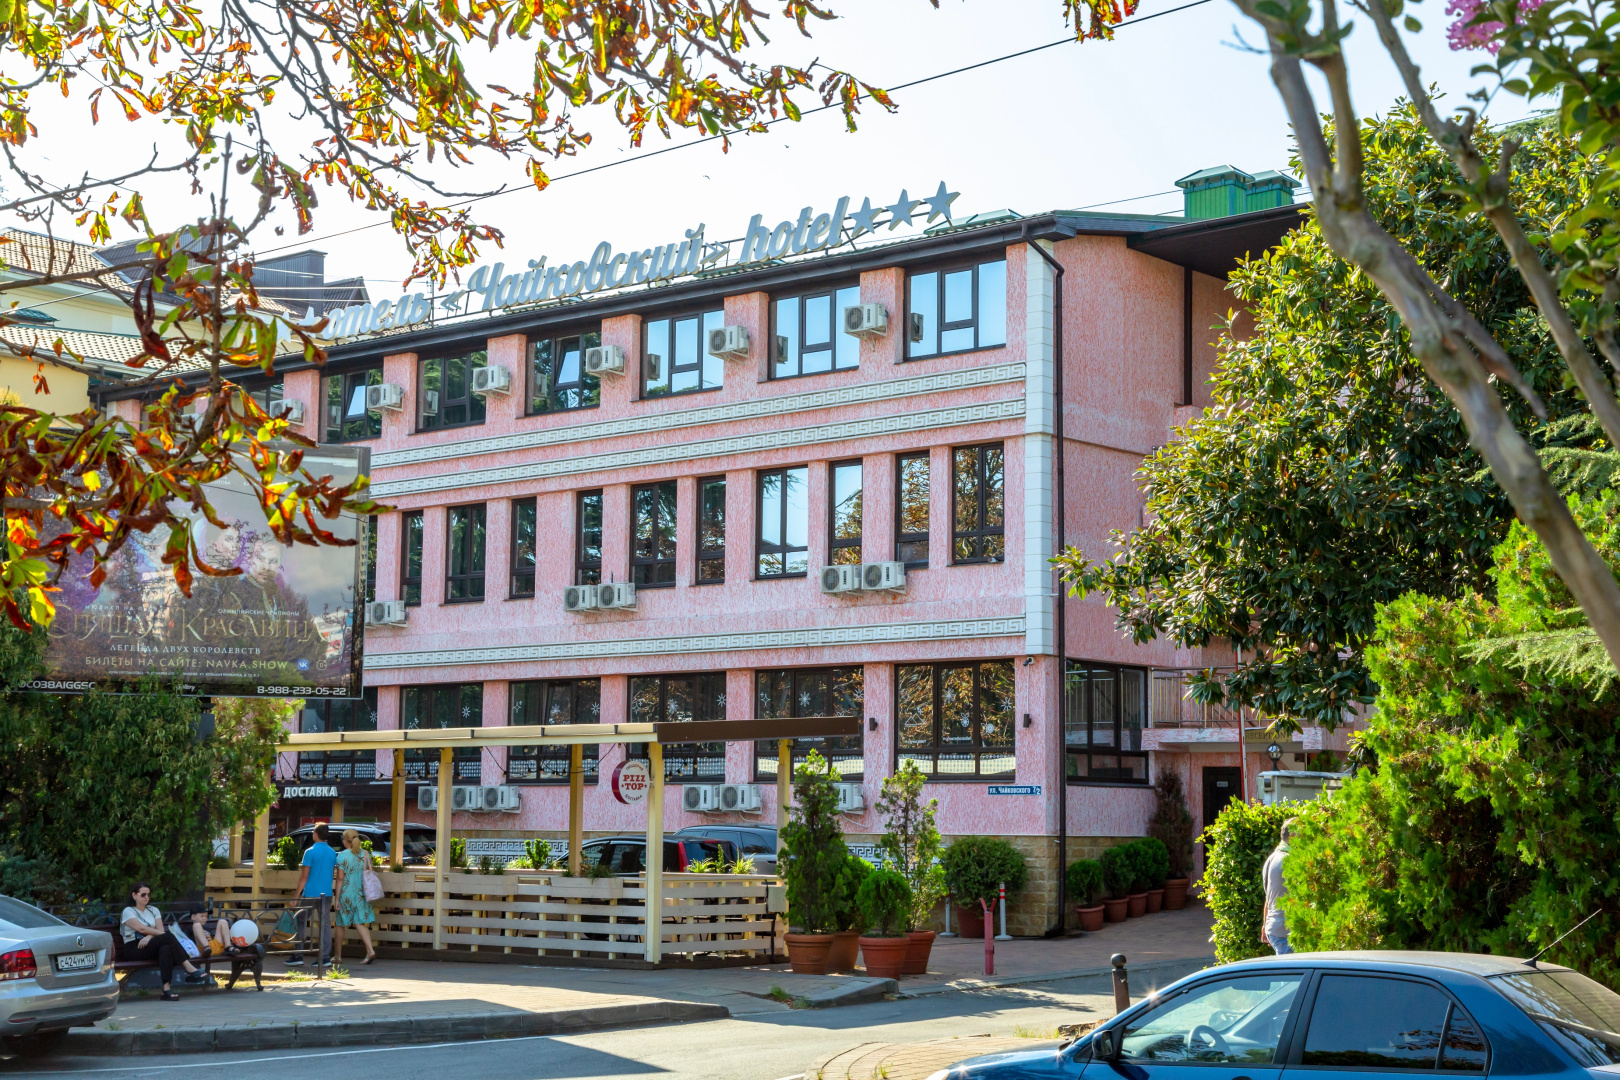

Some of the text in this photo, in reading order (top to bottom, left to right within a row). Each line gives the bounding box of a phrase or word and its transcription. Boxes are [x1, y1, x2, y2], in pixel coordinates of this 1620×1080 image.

[739, 195, 850, 266] hotel
[162, 645, 189, 653] ДВУХ
[193, 646, 261, 655] КОРОЛЕВСТВ
[85, 656, 201, 668] БИЛЕТЫ НА САЙТЕ:
[206, 659, 288, 669] NAVKA.SHOW
[257, 686, 347, 696] 8-988-233-05-22
[1245, 732, 1286, 740] RECEPTON
[623, 774, 646, 782] PIZZ
[625, 782, 644, 790] TOP
[283, 786, 339, 798] ДОСТАВКА
